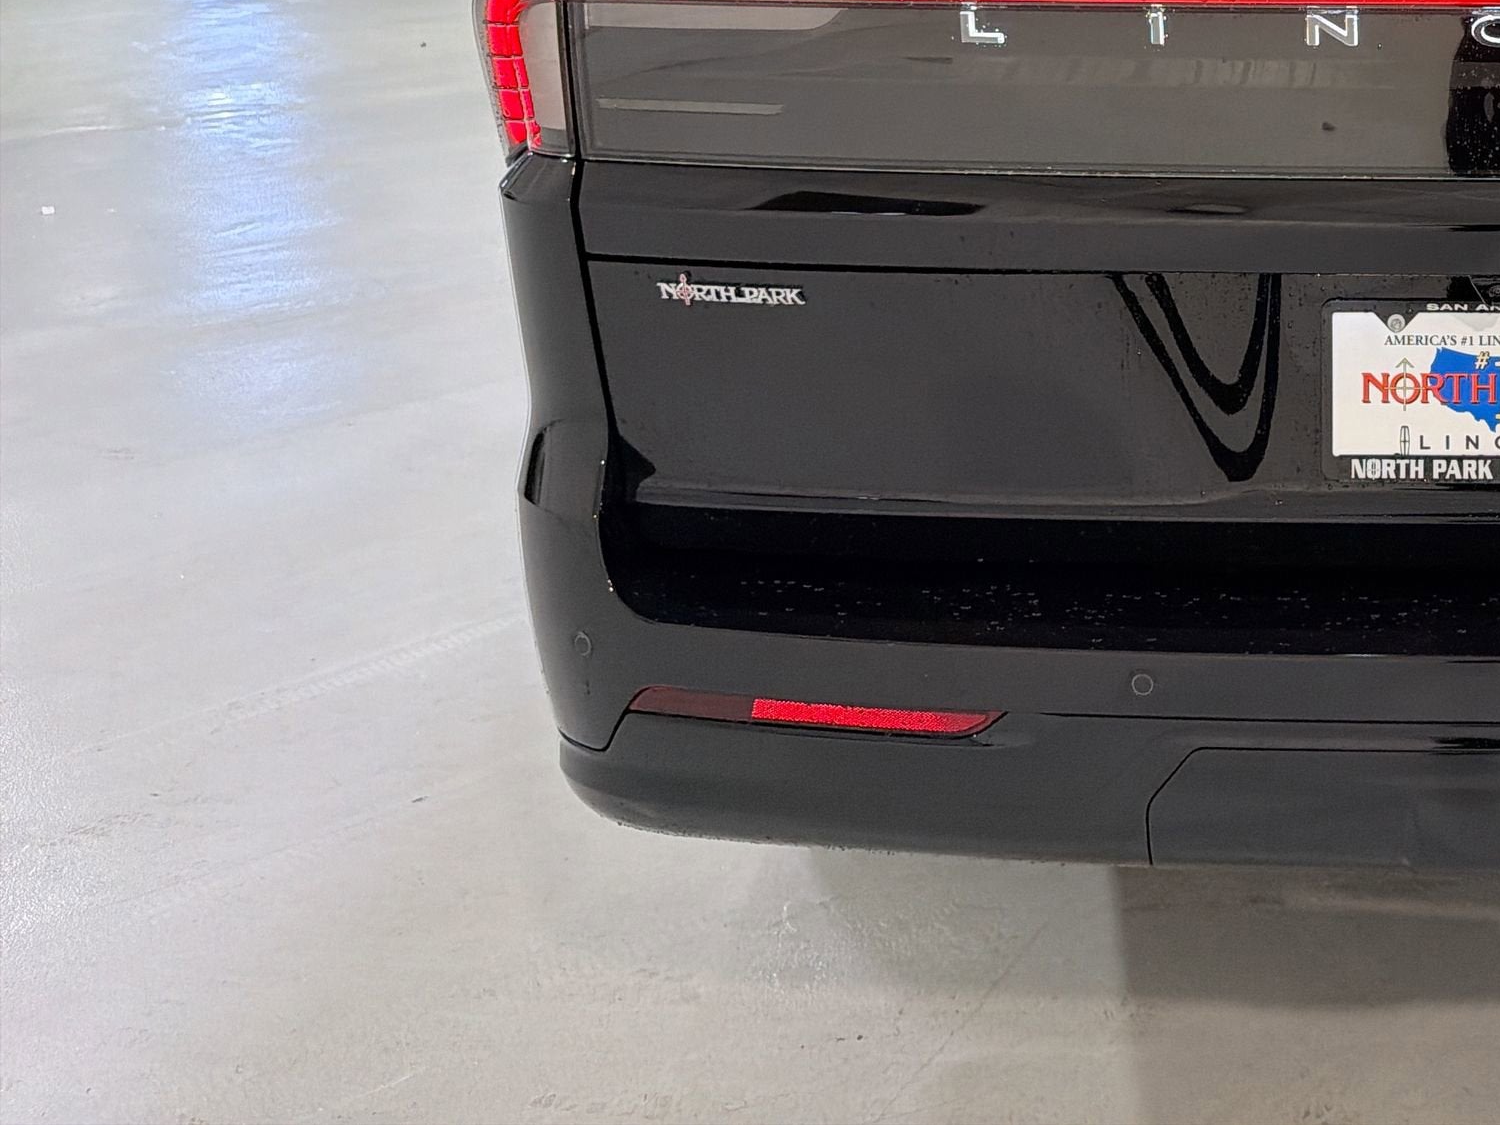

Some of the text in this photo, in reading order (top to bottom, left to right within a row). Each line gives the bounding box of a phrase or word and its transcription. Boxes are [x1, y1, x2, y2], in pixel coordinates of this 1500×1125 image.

[656, 282, 806, 305] NORTH PARK
[1426, 303, 1468, 312] SAN
[1384, 334, 1457, 346] AMERICA'S
[1460, 335, 1474, 346] #1
[1361, 372, 1498, 404] NORTH
[1351, 458, 1425, 480] NORTH
[1432, 459, 1494, 480] PARK
